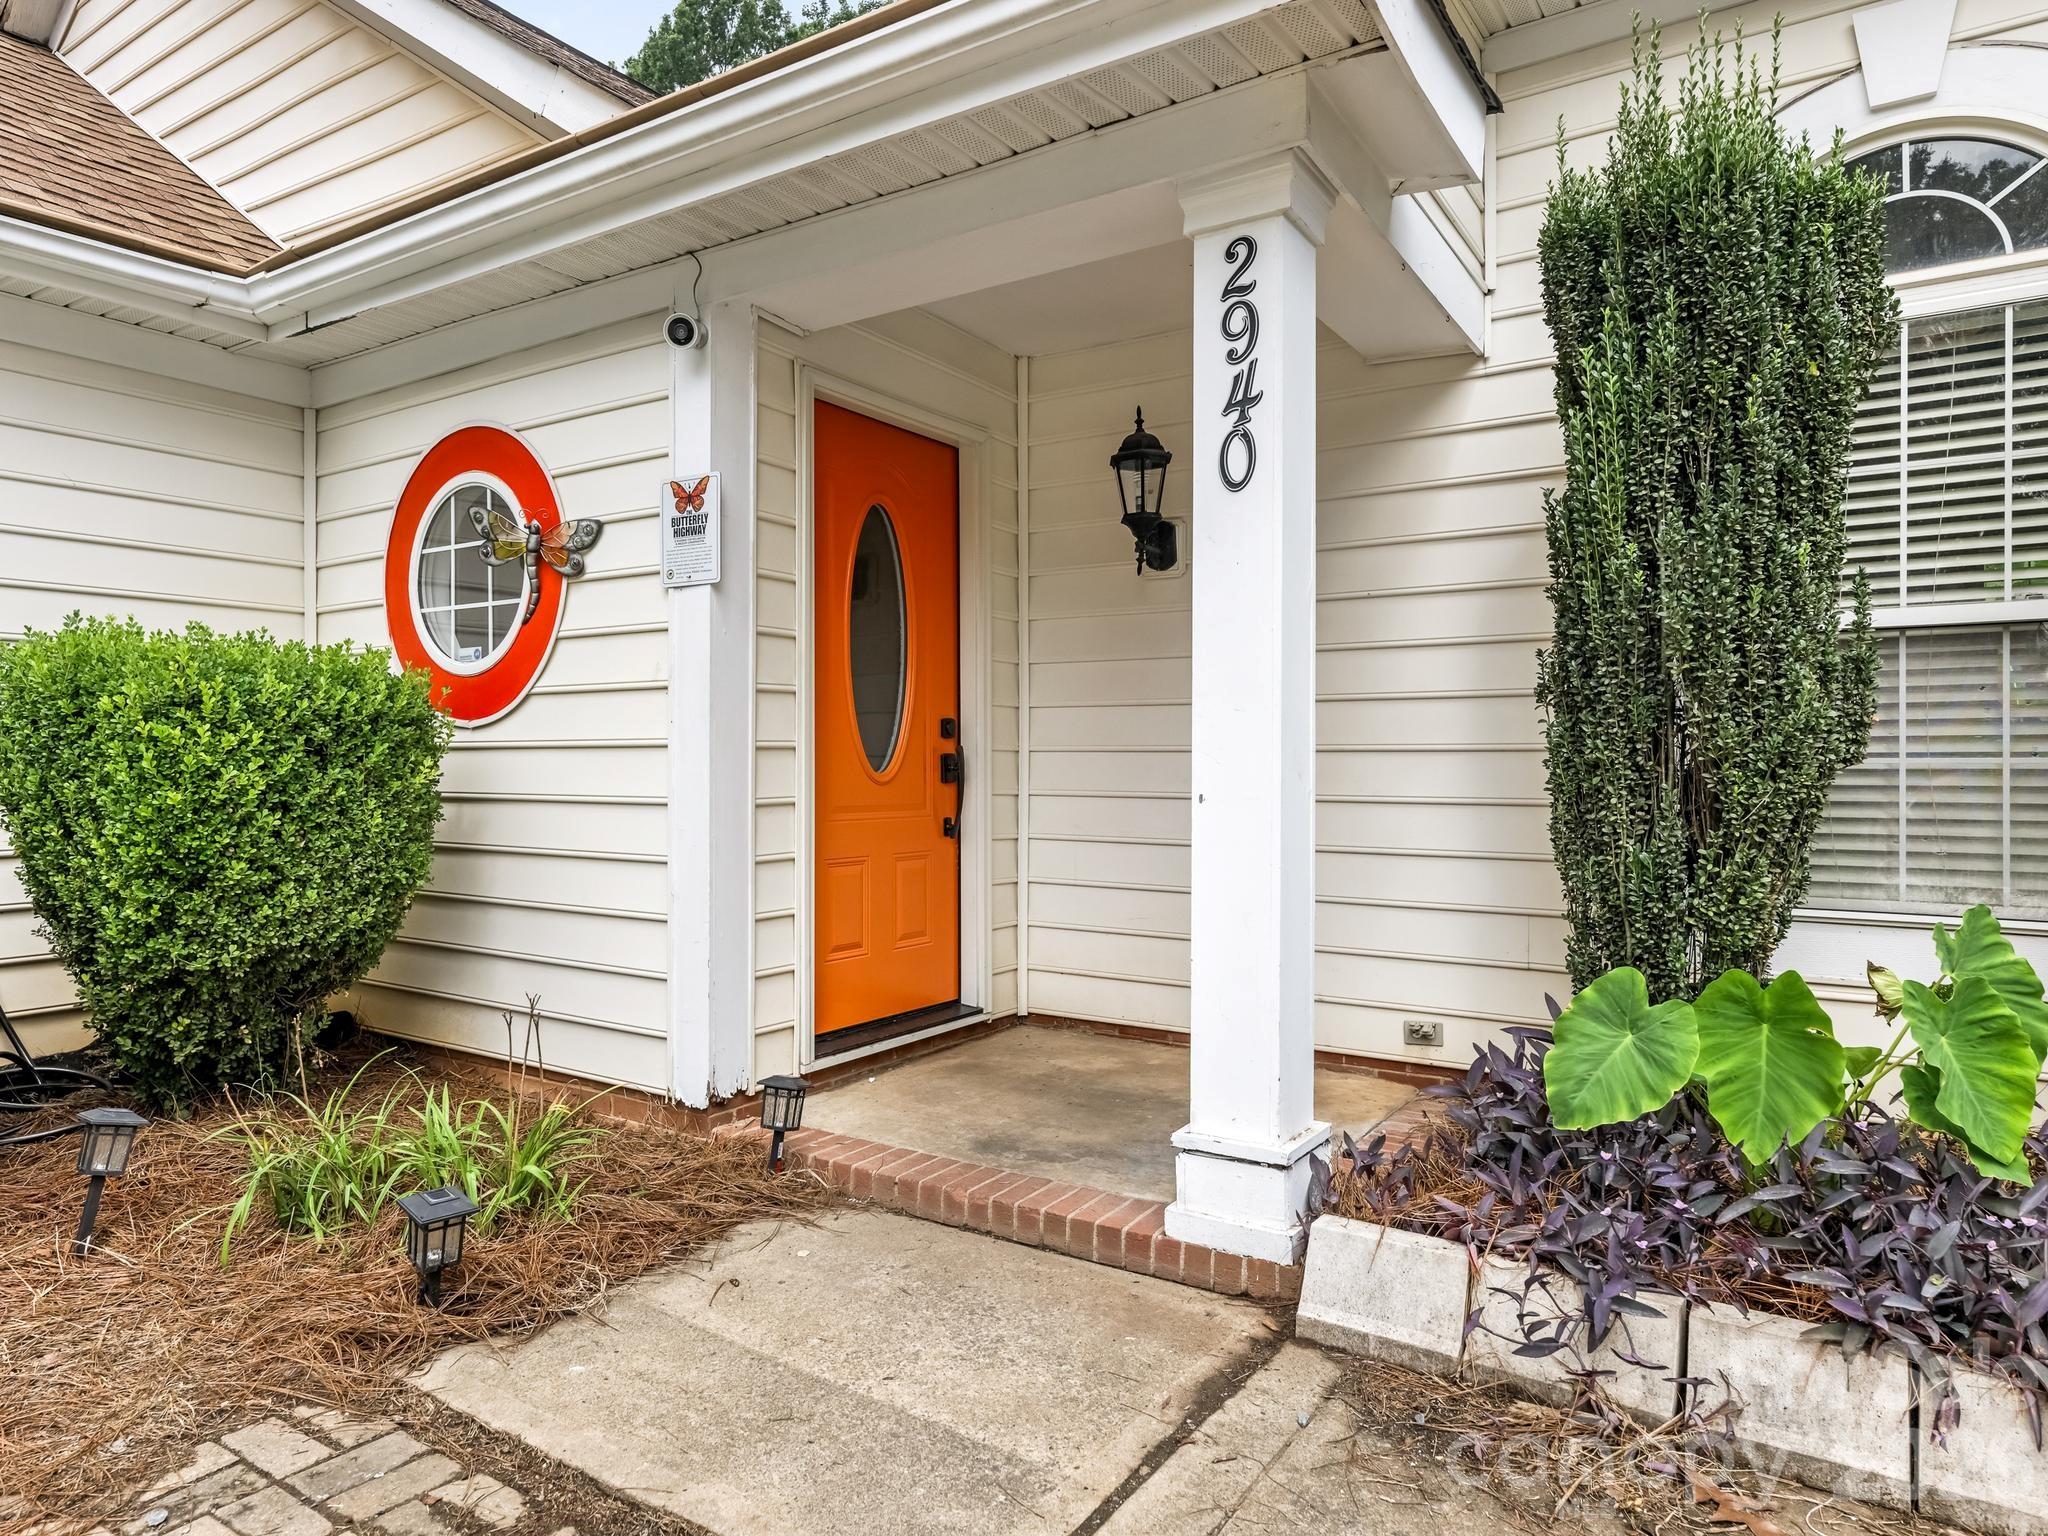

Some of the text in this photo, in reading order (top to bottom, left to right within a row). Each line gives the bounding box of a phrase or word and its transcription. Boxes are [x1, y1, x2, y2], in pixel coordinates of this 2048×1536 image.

[1219, 235, 1264, 493] 2940
[671, 513, 708, 527] BUTTERFLY
[673, 524, 706, 538] HIGHWAY
